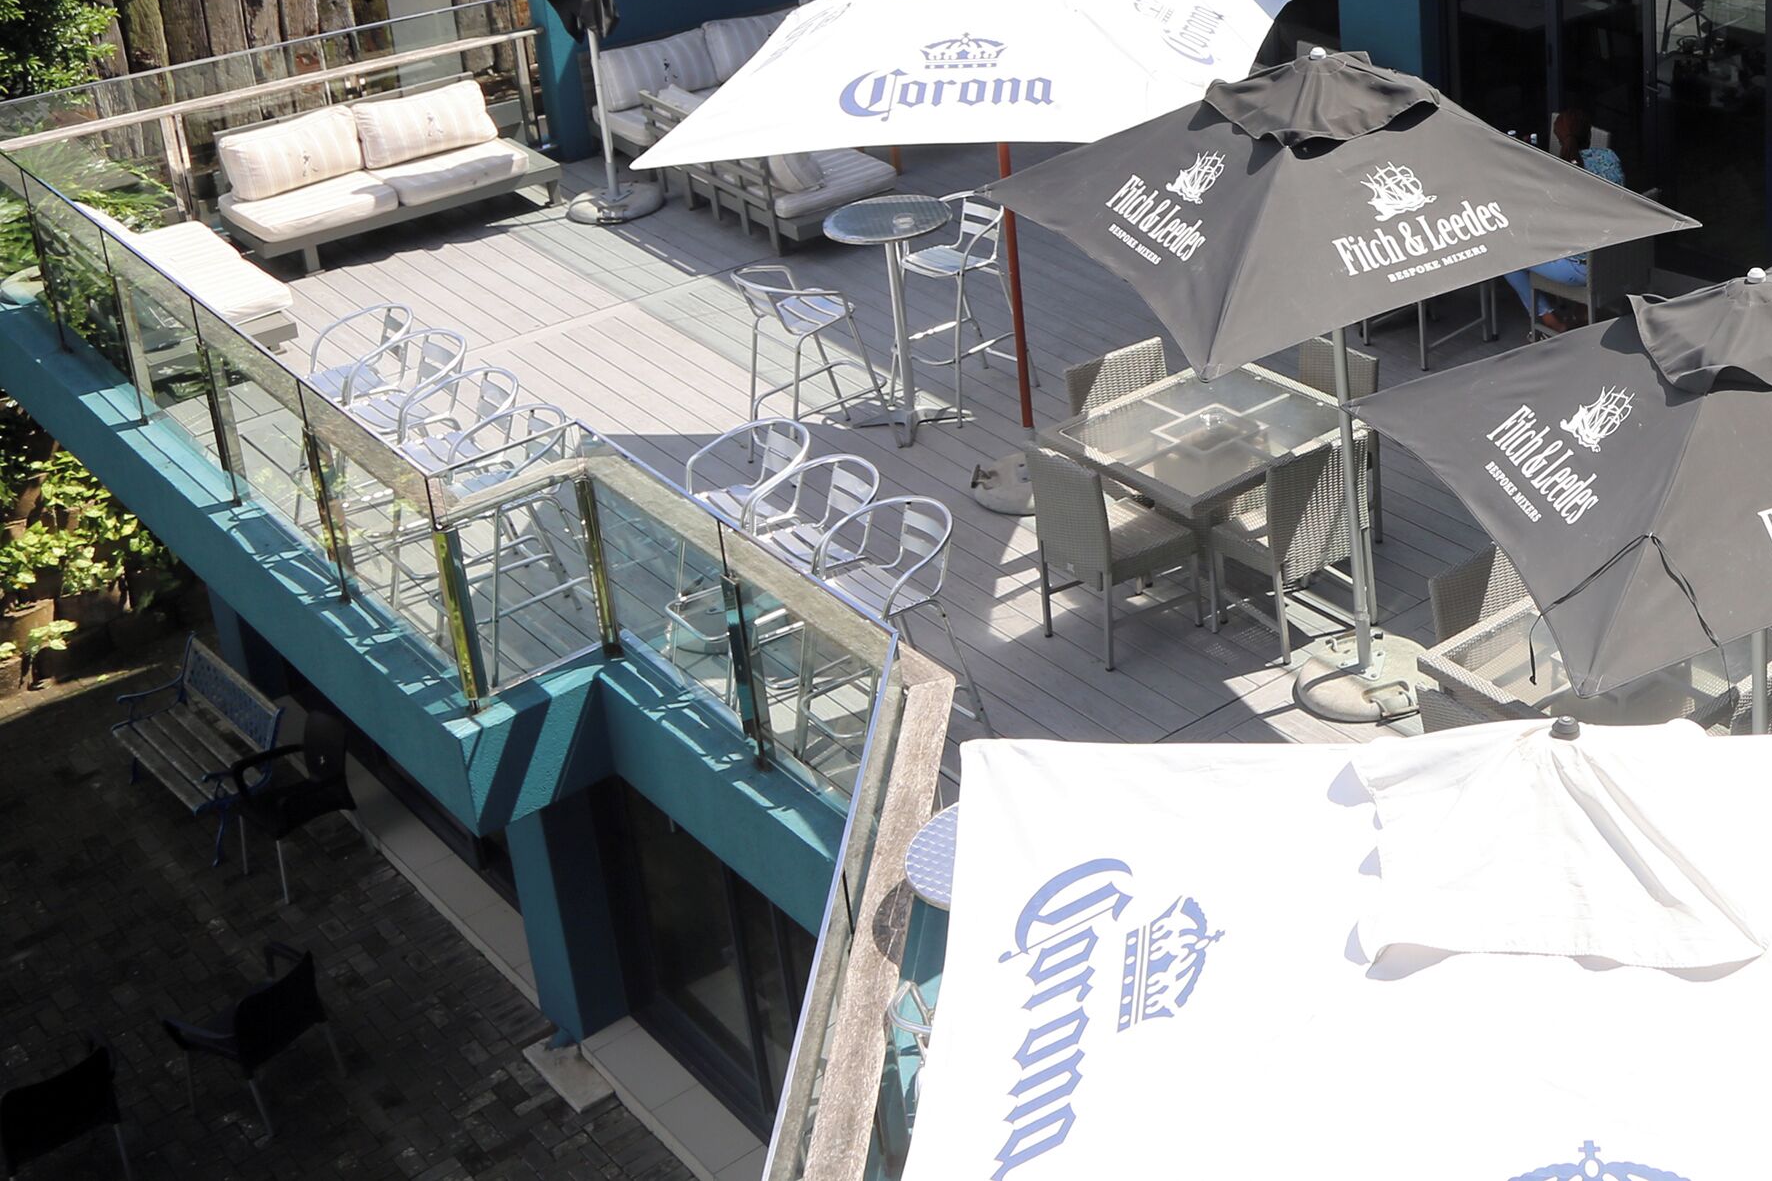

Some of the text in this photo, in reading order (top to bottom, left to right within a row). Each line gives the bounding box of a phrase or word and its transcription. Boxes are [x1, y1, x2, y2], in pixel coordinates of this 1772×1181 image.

[1160, 5, 1224, 65] Corona
[839, 68, 1054, 122] Corona
[1105, 174, 1206, 262] Fitch & Leedes
[1108, 223, 1162, 265] BESPOKE MIXERS
[1332, 200, 1509, 276] Fitch & Leedes
[1387, 244, 1488, 283] BESPOKE MIXERS
[1485, 460, 1542, 523] BESPOKE MIXERS
[1486, 404, 1600, 525] Fitch & Leedes
[989, 858, 1133, 1181] Corona
